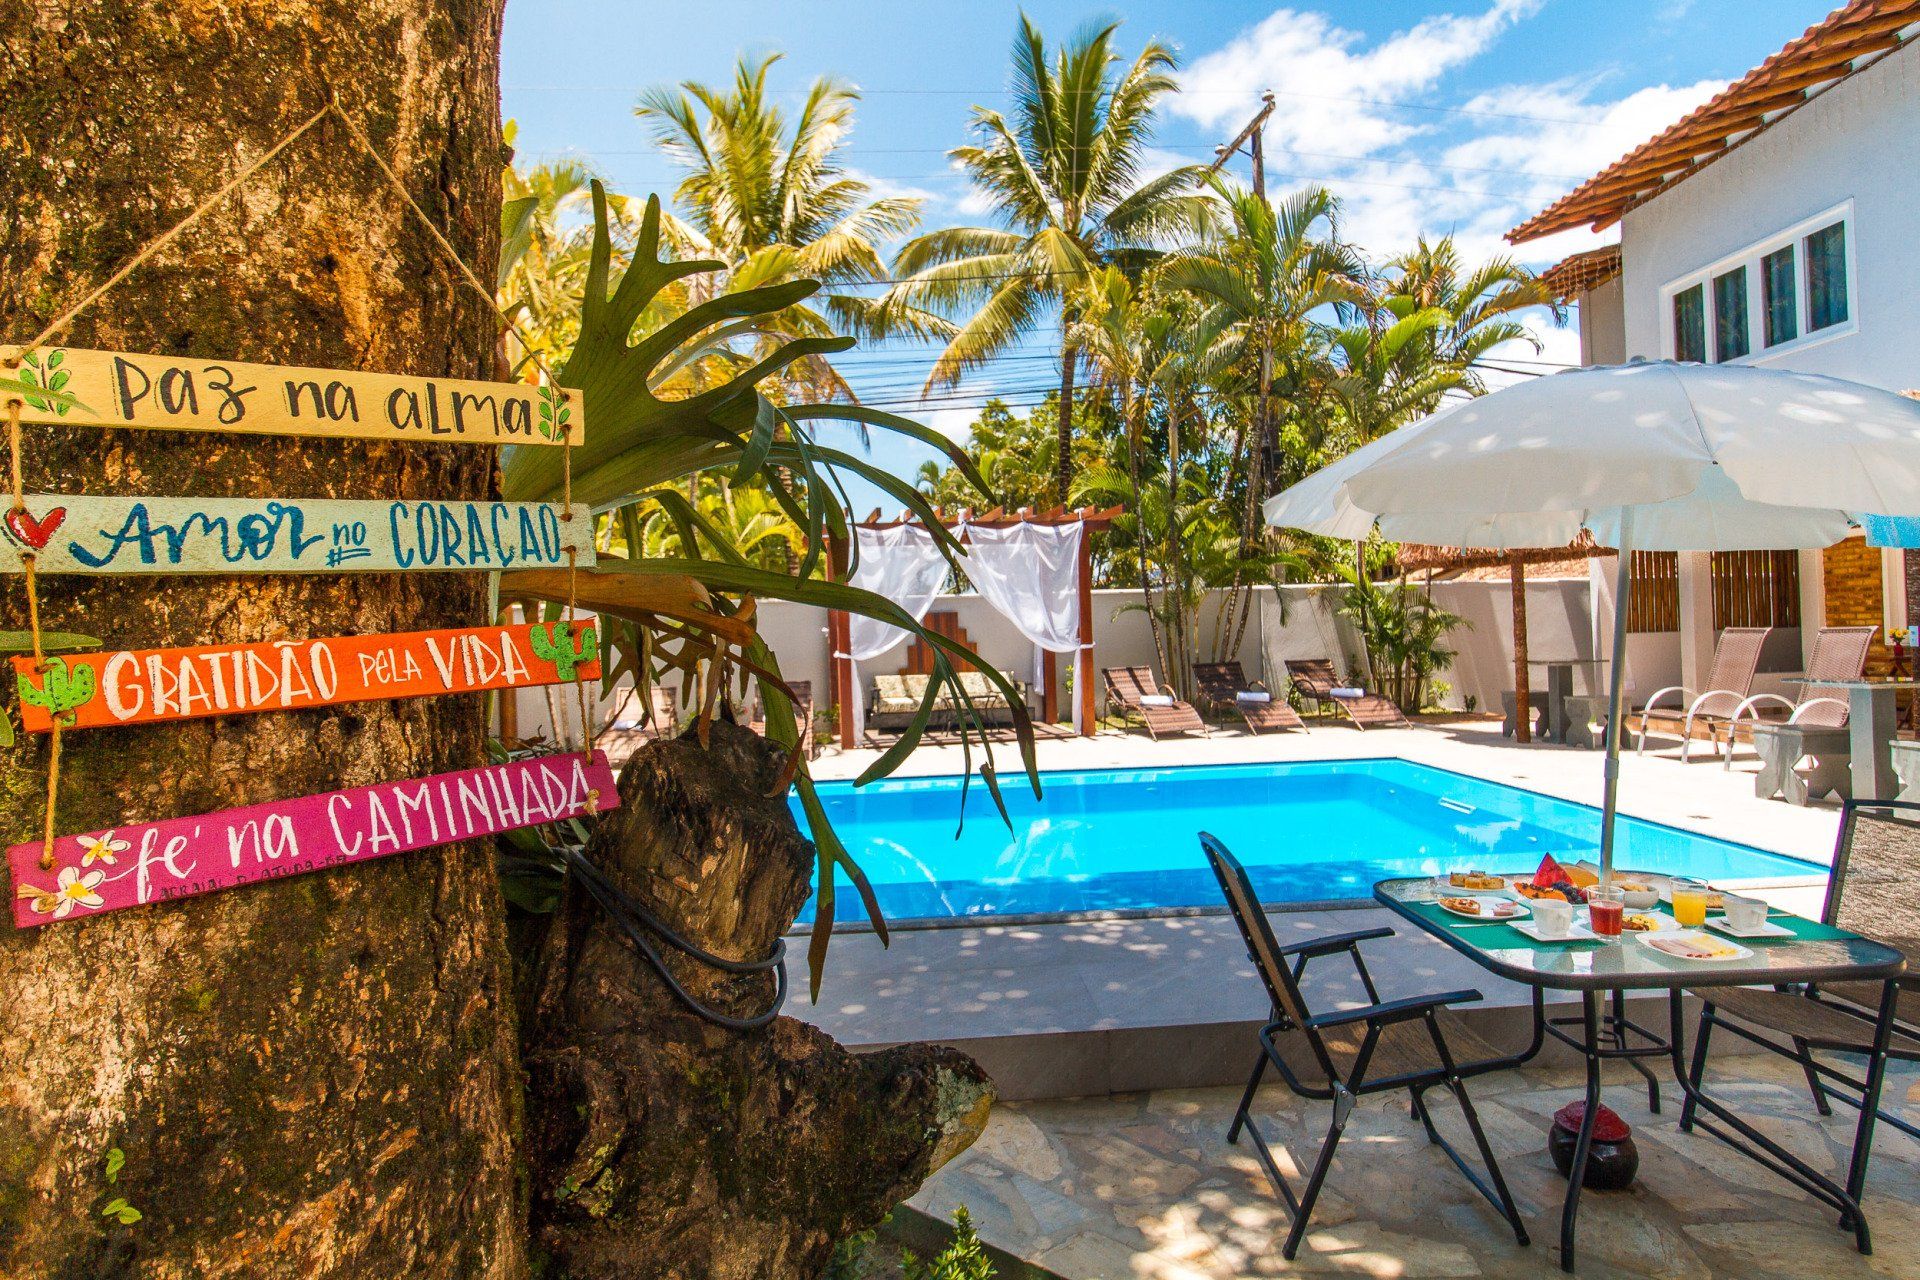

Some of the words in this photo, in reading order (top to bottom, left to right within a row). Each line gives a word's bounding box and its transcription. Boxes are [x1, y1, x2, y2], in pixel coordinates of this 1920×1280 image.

[284, 380, 359, 422] na
[333, 521, 367, 546] no
[102, 641, 338, 720] GRATIDÃO
[425, 631, 531, 689] VIDA
[227, 814, 299, 868] na
[327, 759, 600, 856] CAMINHADA
